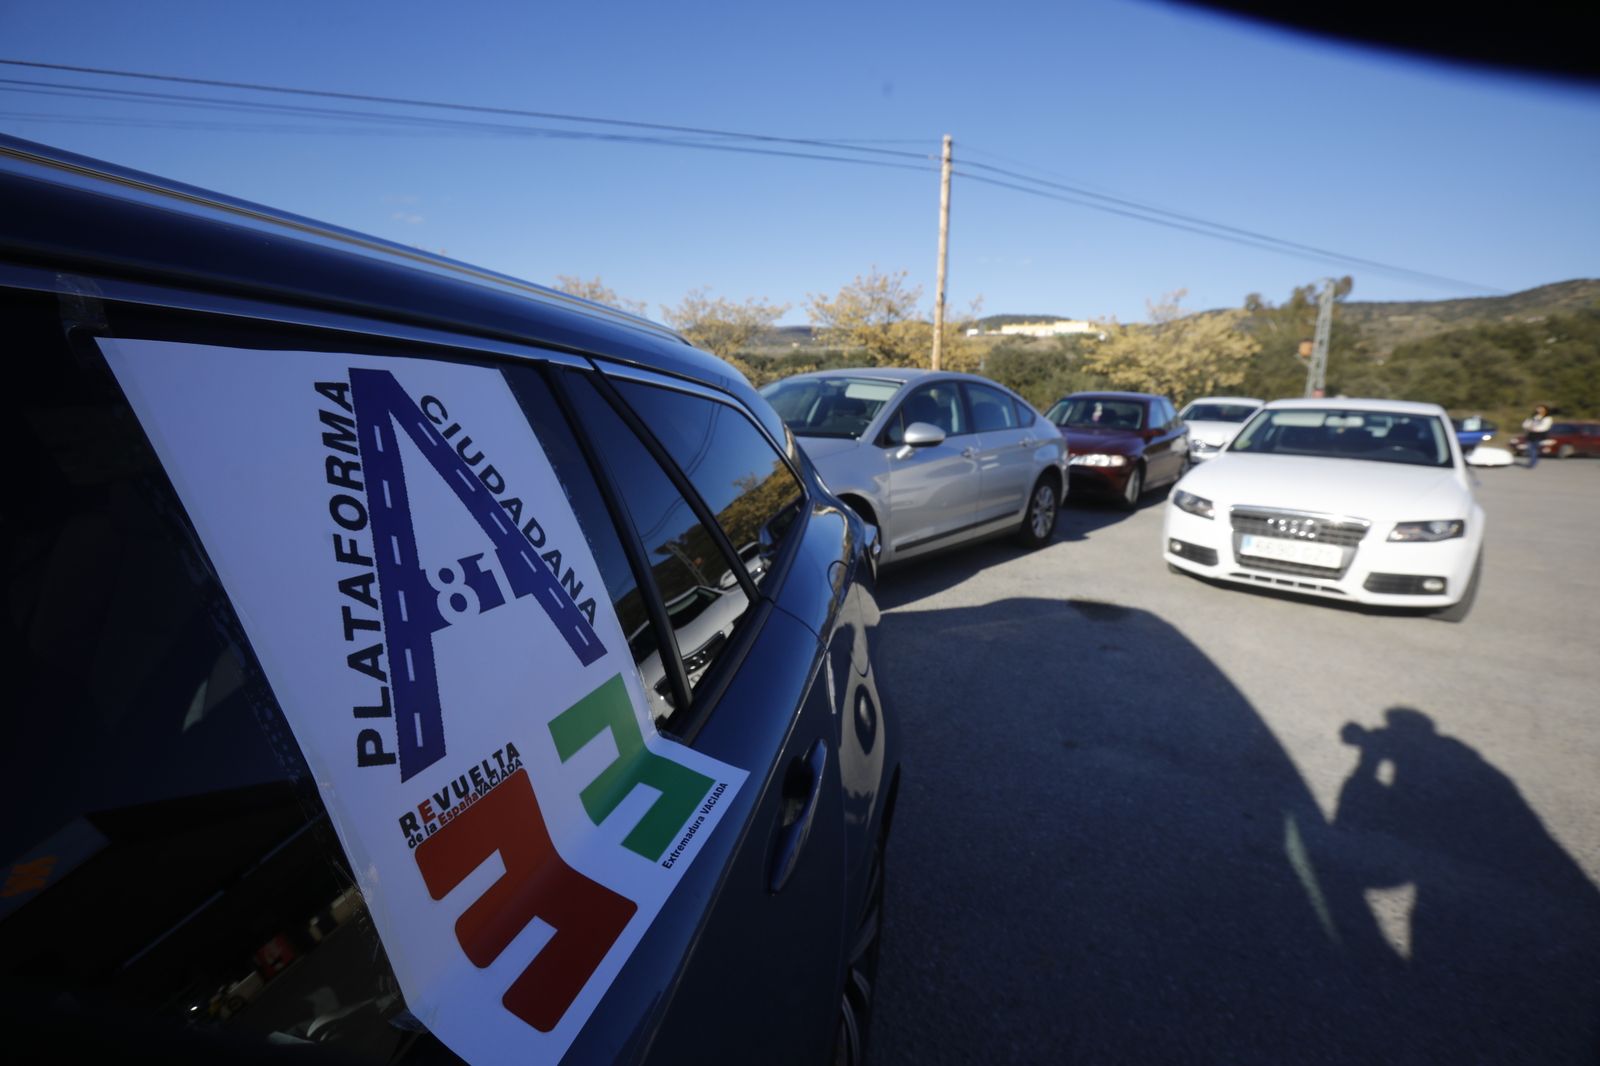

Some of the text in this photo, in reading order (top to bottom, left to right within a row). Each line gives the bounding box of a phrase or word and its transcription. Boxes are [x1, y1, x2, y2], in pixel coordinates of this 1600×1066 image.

[420, 394, 598, 628] CIUDADANA
[314, 381, 397, 767] PLATAFORMA
[425, 549, 517, 626] 81
[398, 742, 521, 838] REVUELTA
[408, 833, 423, 849] de
[424, 822, 437, 836] la
[662, 782, 728, 869] Extremadura VACIADA
